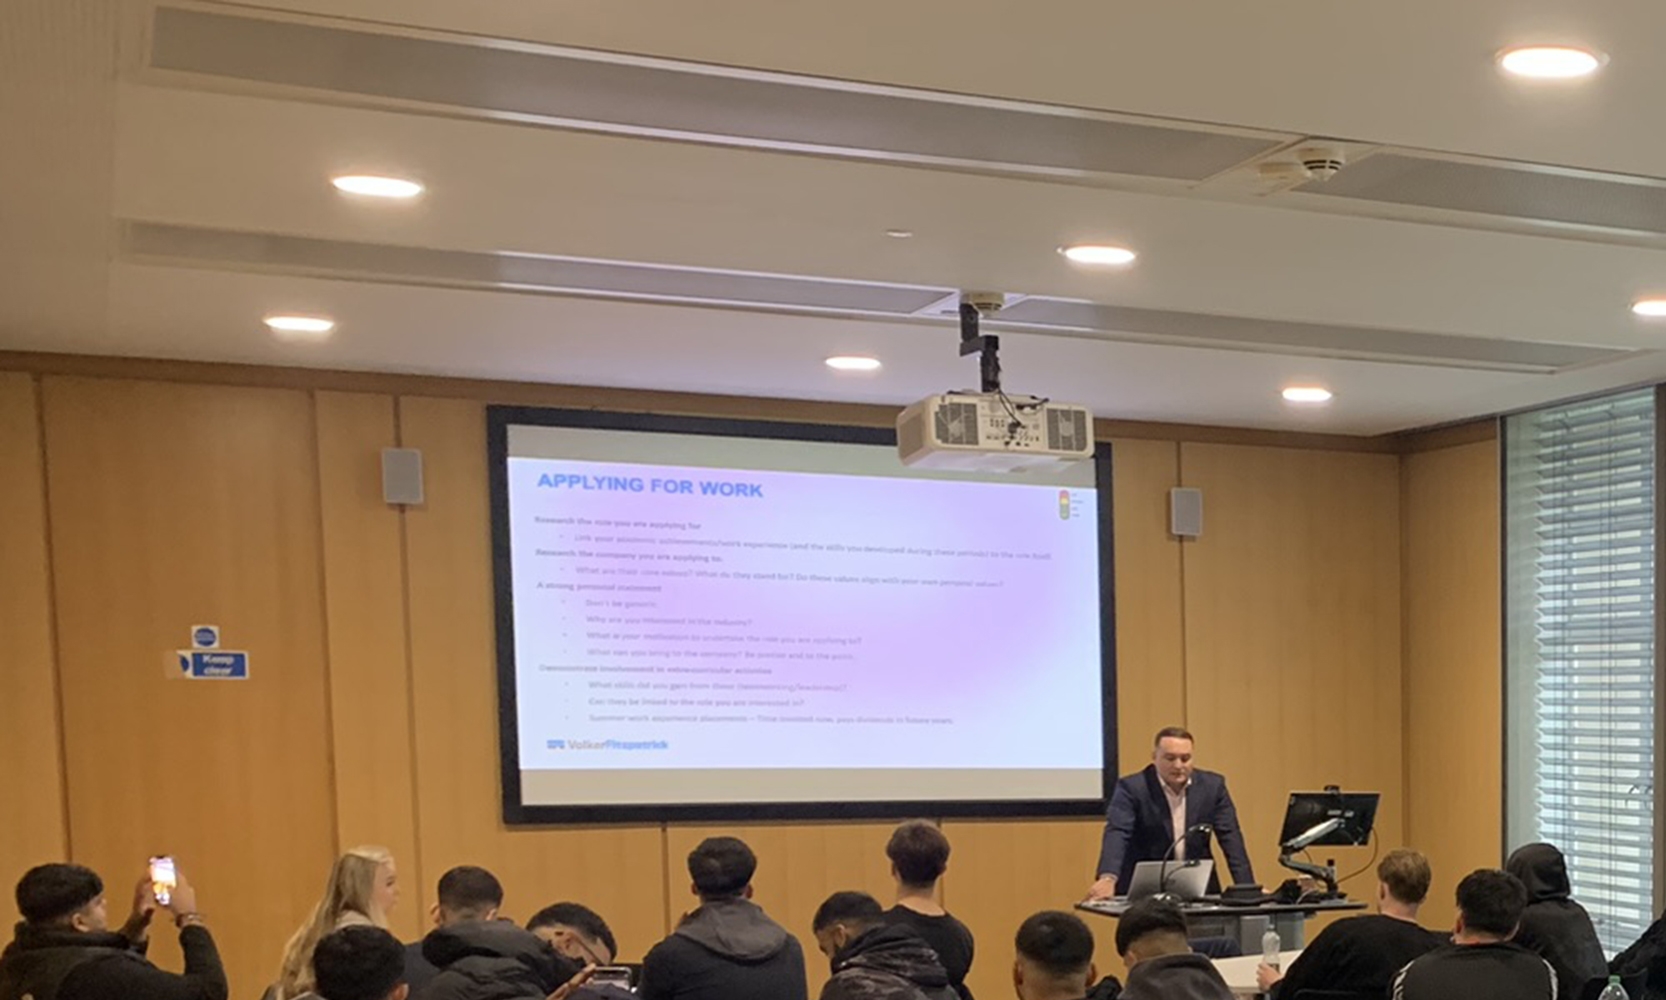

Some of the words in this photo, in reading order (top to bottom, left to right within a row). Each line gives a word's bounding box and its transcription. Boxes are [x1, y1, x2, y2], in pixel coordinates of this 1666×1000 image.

[537, 473, 644, 493] APPLYING
[650, 478, 693, 495] FOR
[699, 481, 763, 498] WORK
